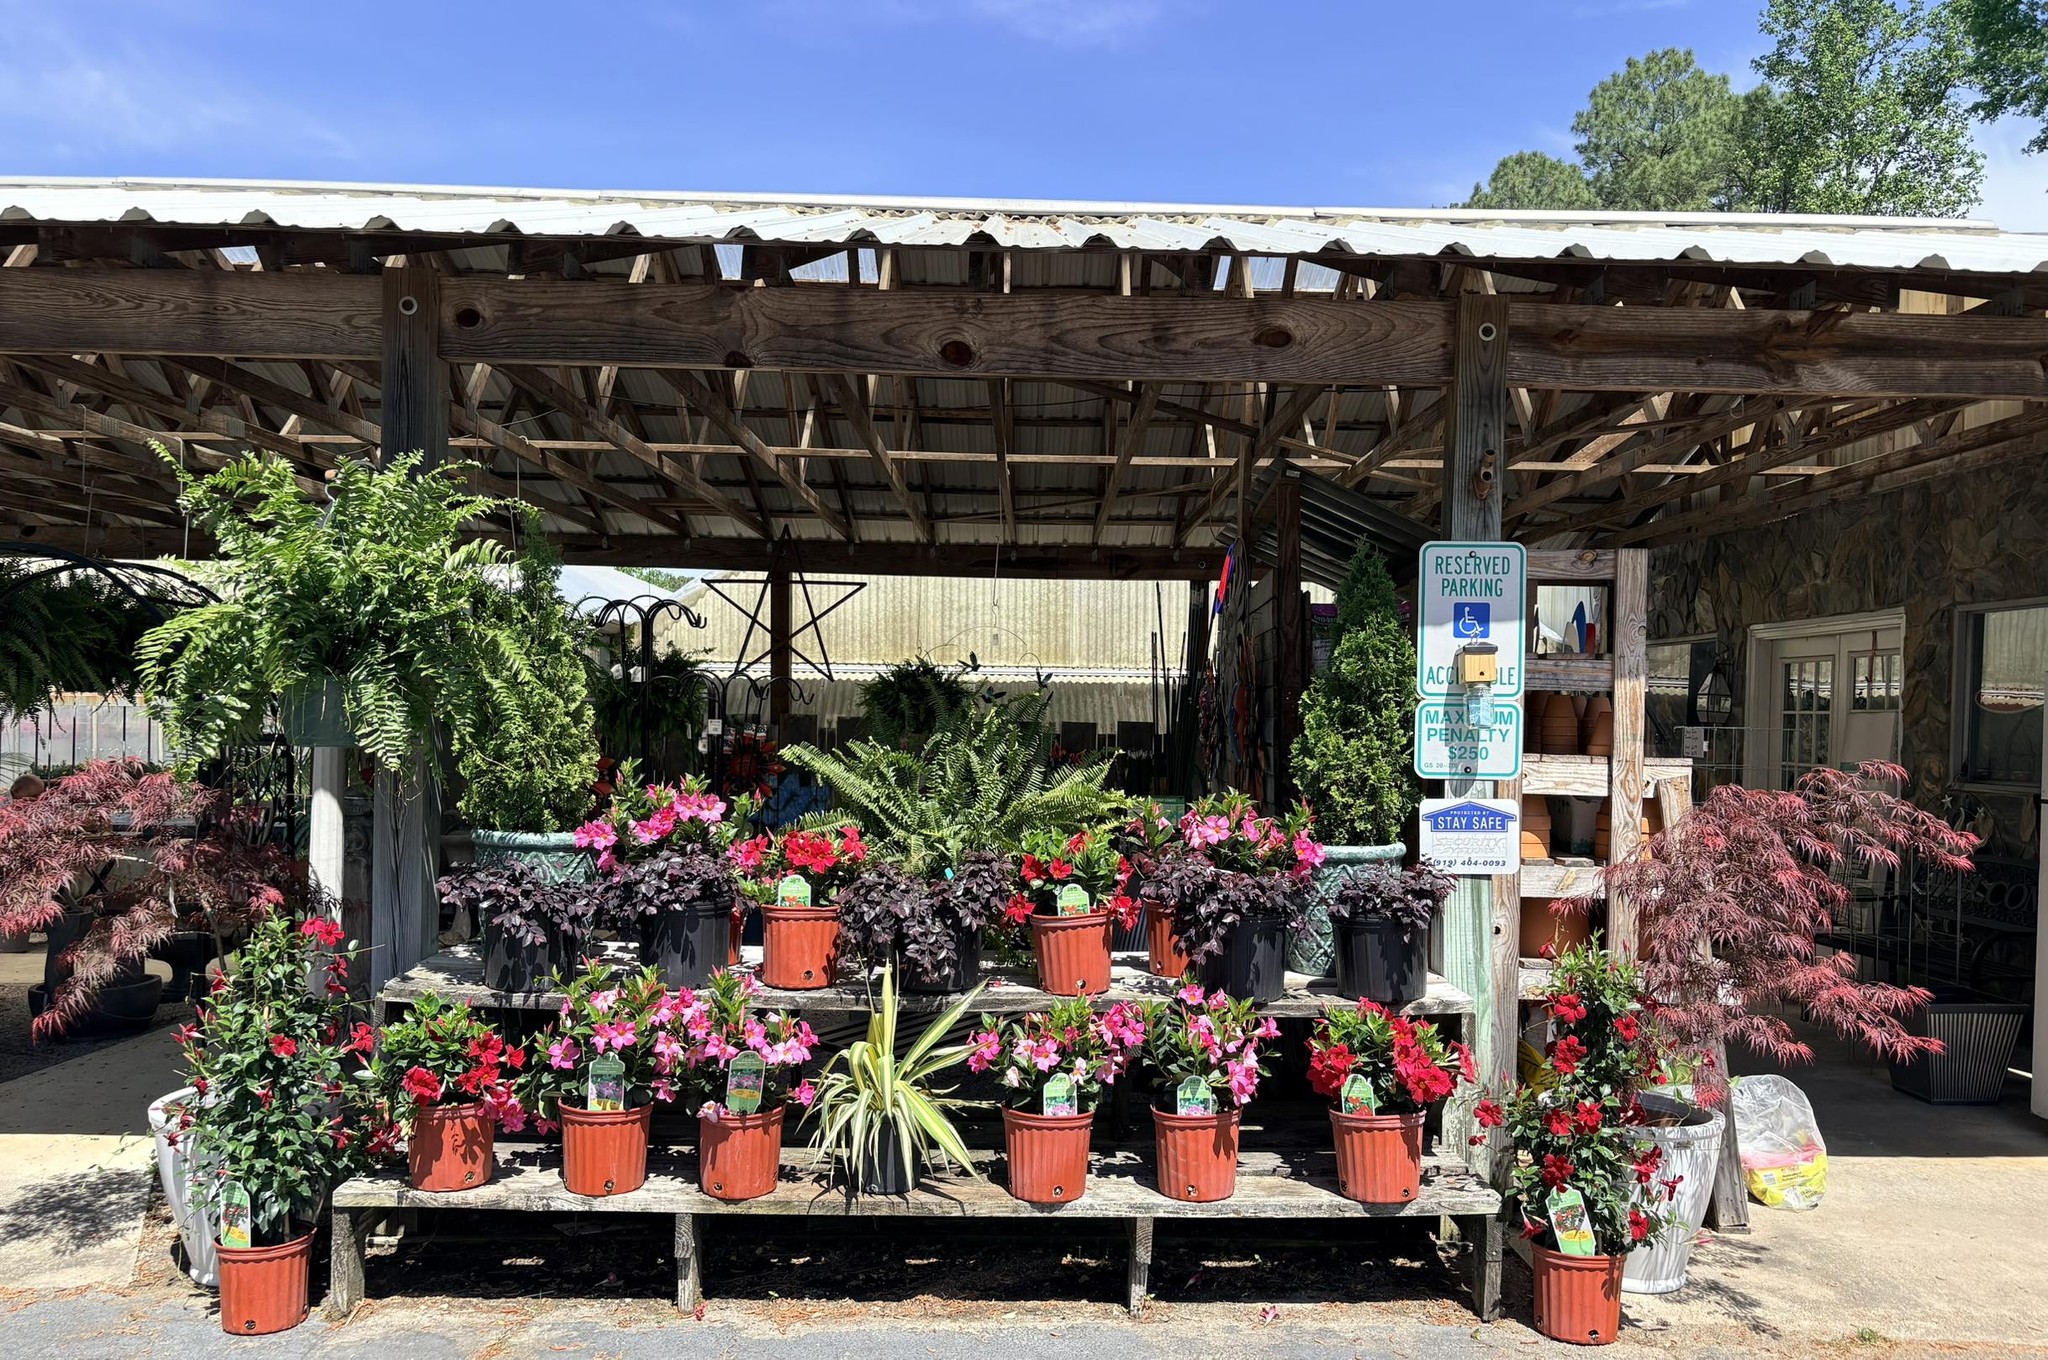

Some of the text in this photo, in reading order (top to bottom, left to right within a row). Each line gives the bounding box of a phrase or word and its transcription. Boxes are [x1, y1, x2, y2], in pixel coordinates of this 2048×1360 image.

[1435, 556, 1511, 575] RESERVED
[1441, 578, 1503, 597] PARKING
[1426, 666, 1516, 686] ACCLE
[1427, 728, 1510, 743] PENALTY
[1448, 745, 1489, 760] $250
[1437, 816, 1502, 830] STAY SAFE
[1460, 859, 1507, 867] 404-0093
